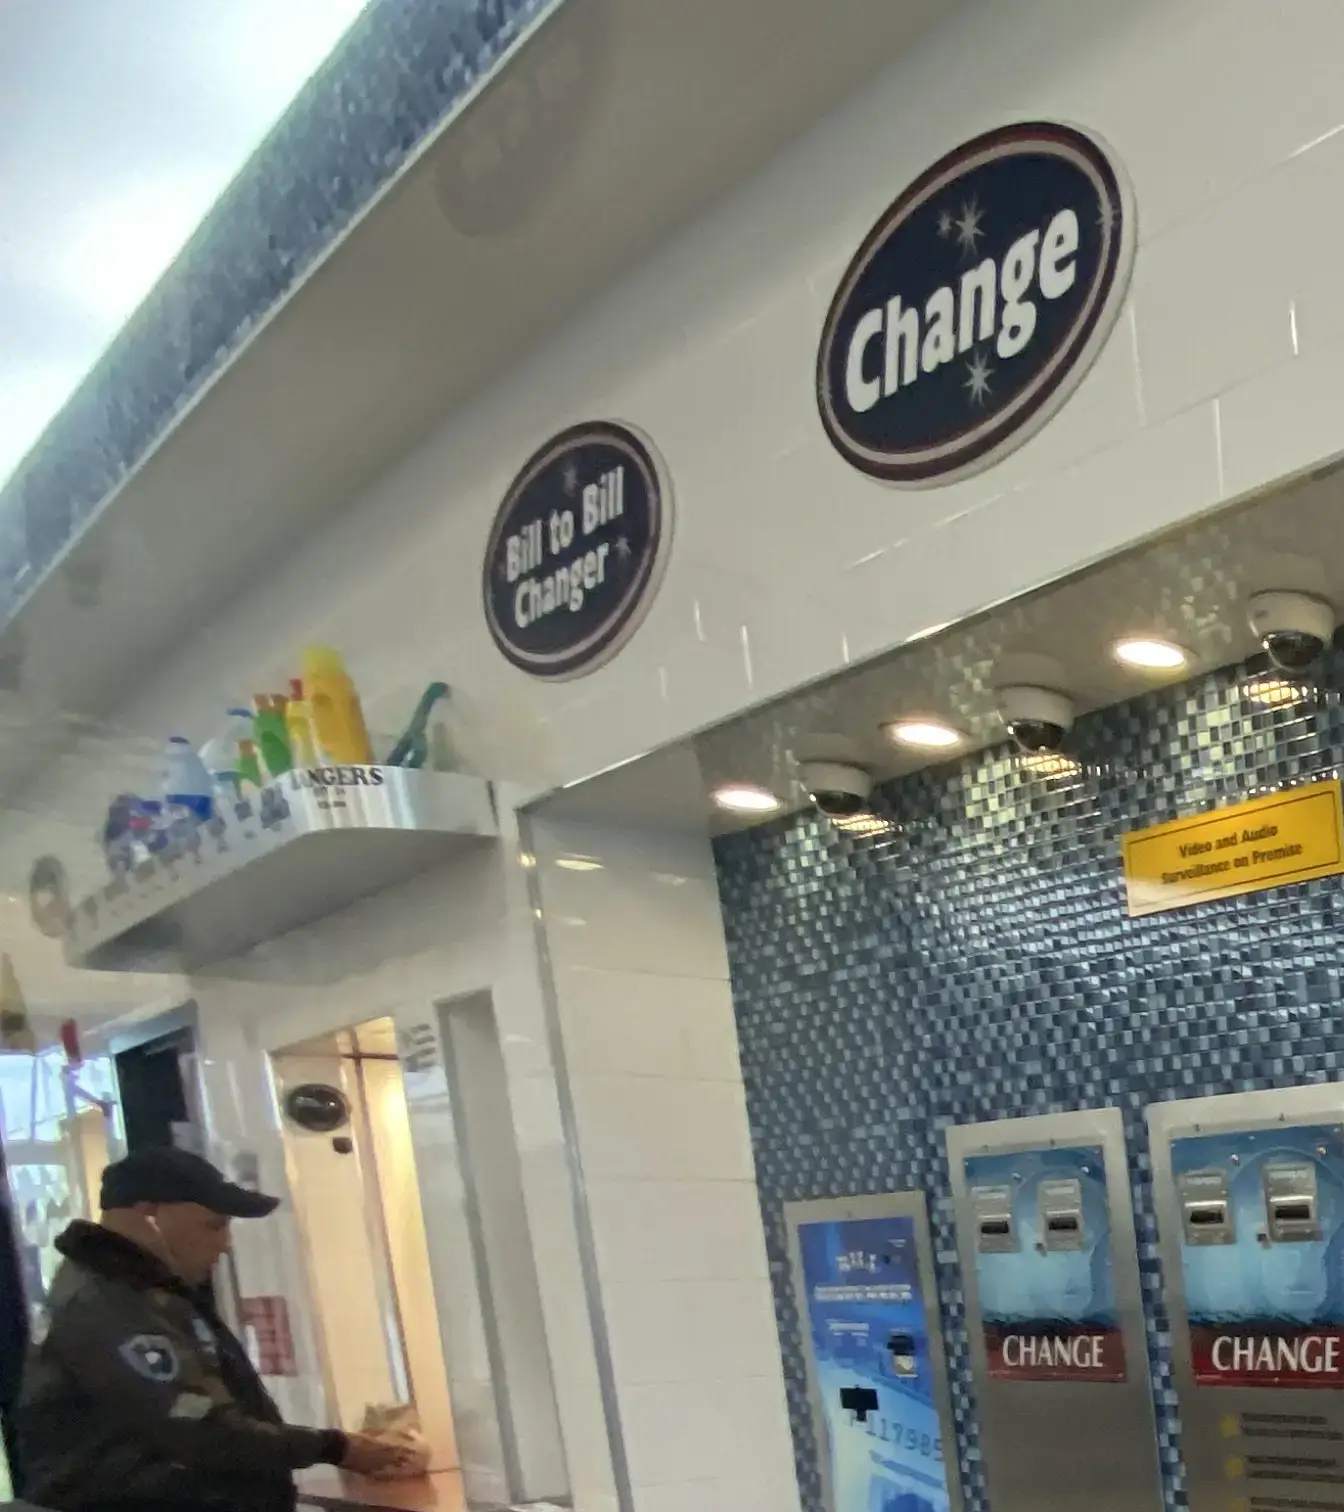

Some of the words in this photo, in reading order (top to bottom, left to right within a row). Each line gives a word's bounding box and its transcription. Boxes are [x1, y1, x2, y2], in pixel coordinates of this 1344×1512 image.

[845, 208, 1080, 413] Change
[506, 519, 543, 583] Bill
[550, 509, 575, 555] to
[582, 465, 625, 536] Bill
[514, 541, 610, 629] Changer
[1179, 842, 1212, 858] Video
[1214, 831, 1238, 850] and
[1240, 824, 1279, 843] Audio
[1233, 856, 1249, 868] on
[1003, 1334, 1106, 1369] CHANGE
[1211, 1335, 1341, 1373] CHANGE
